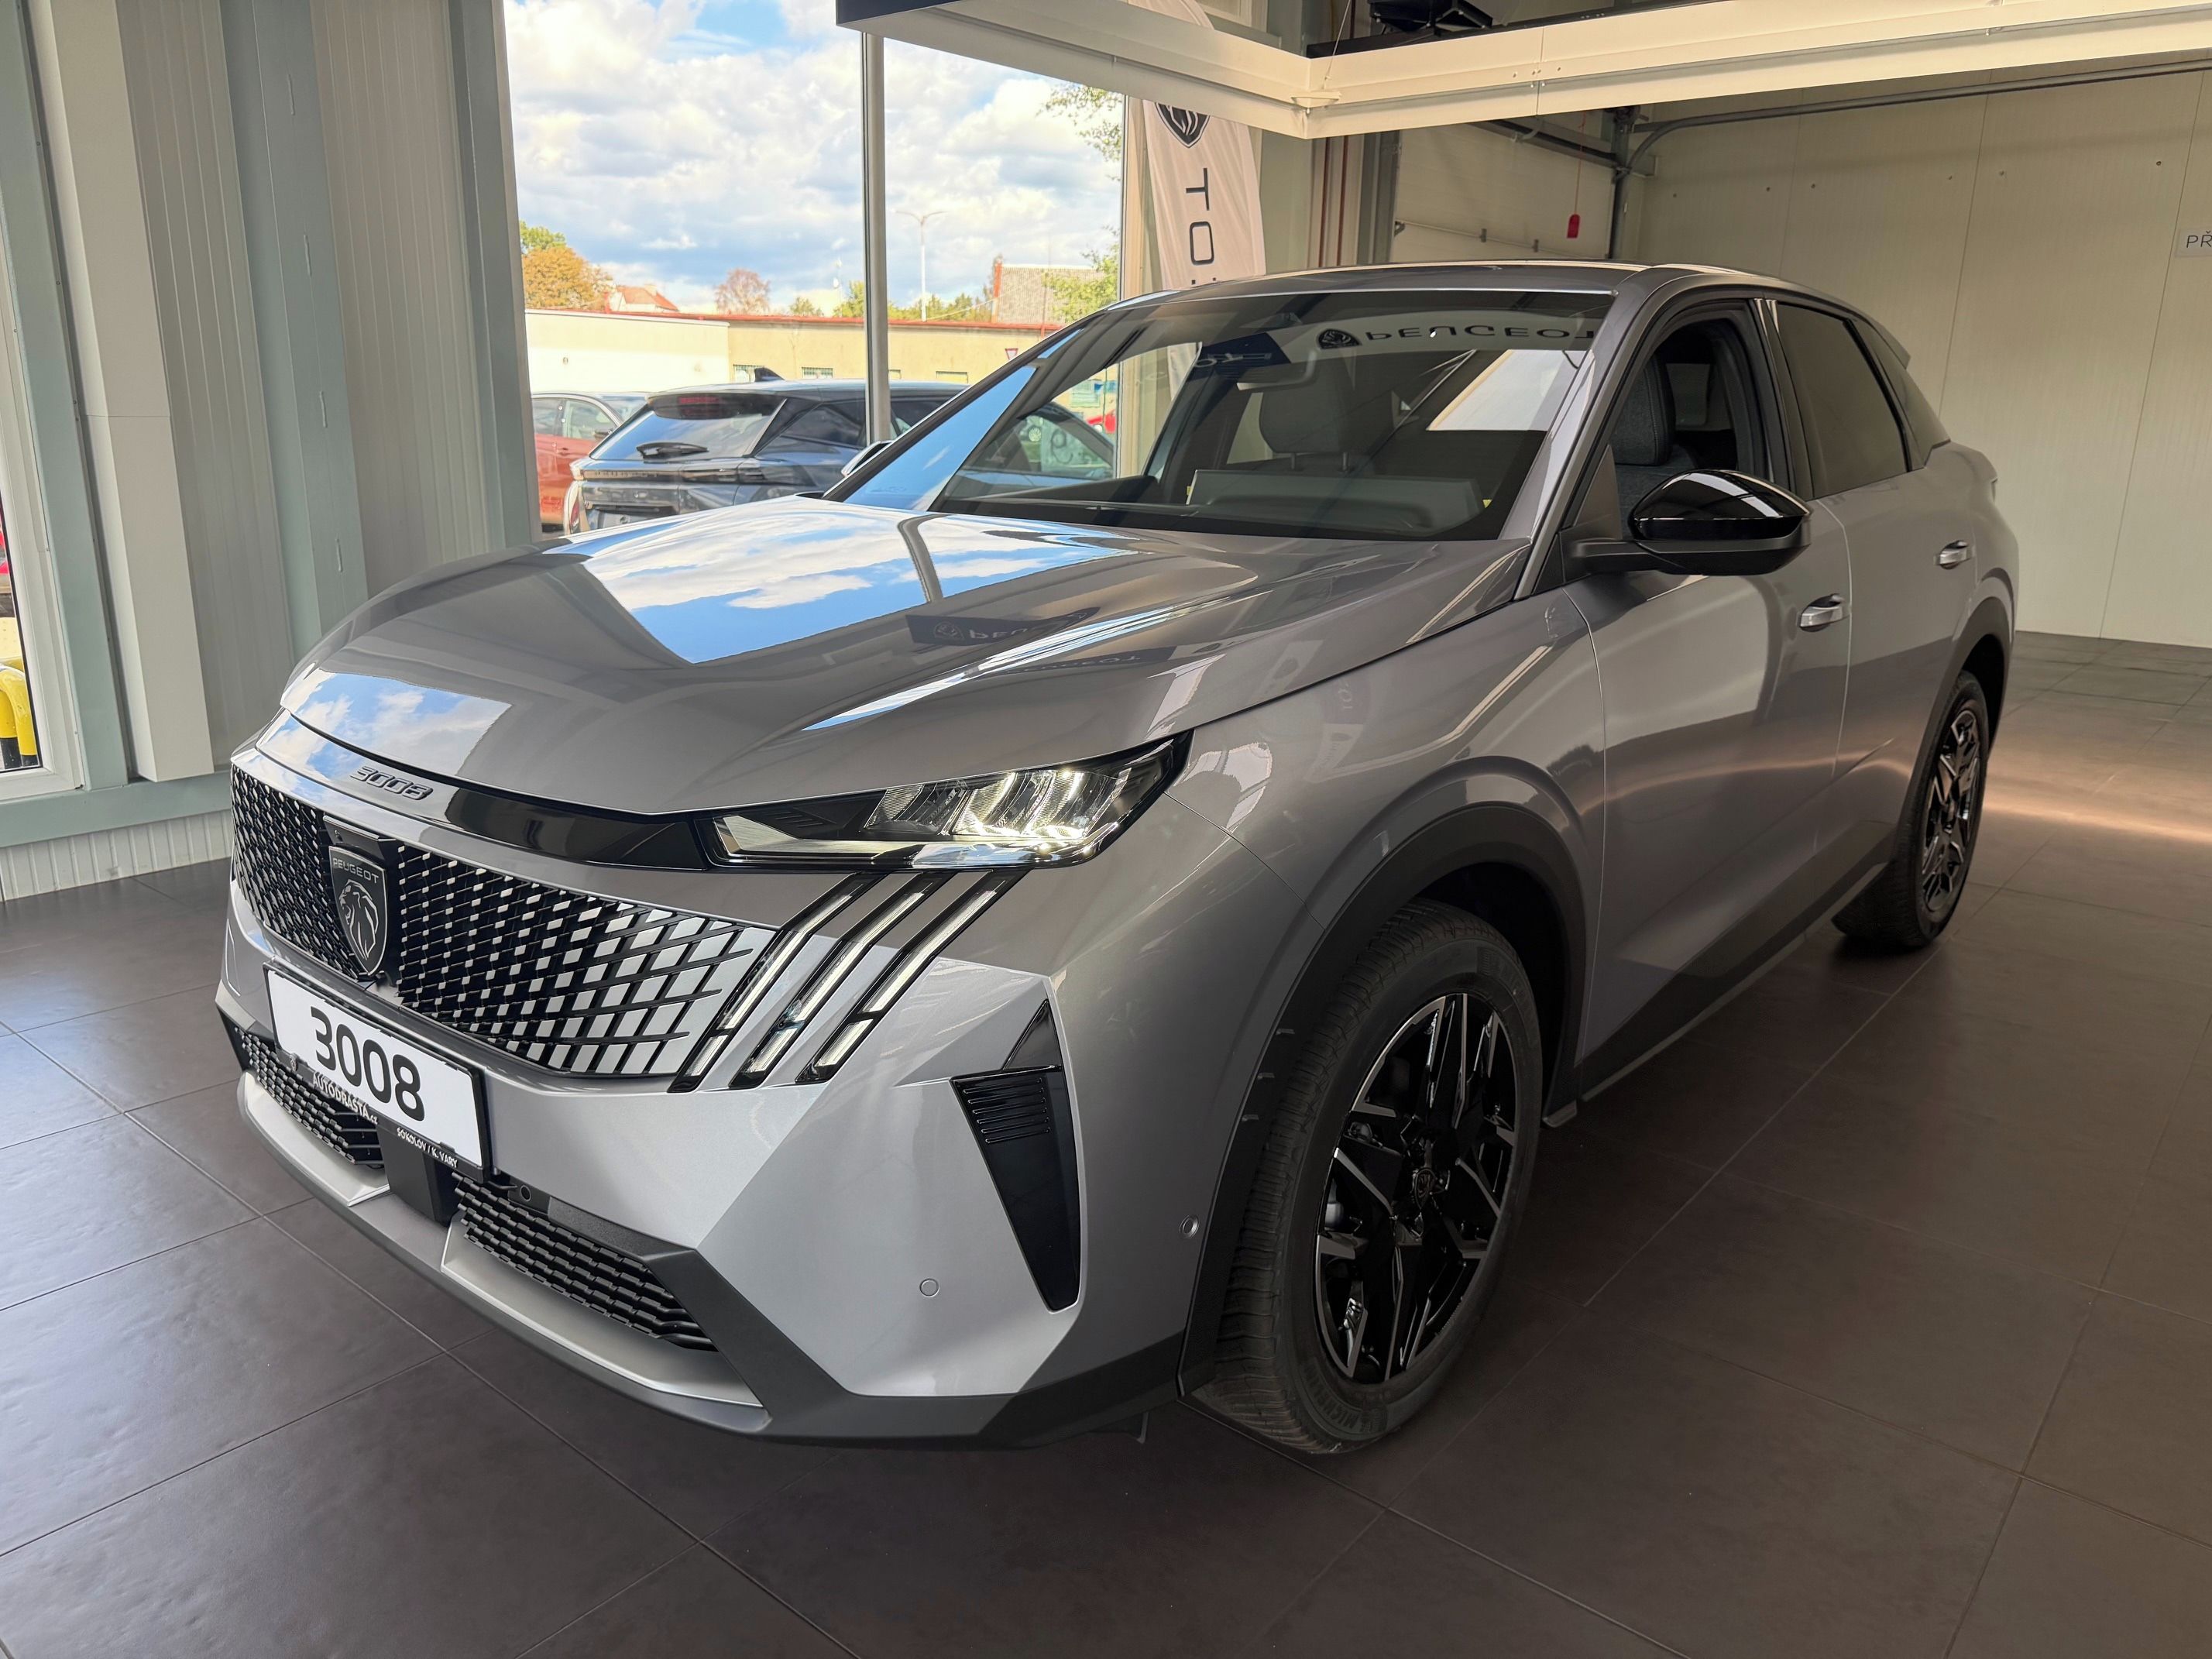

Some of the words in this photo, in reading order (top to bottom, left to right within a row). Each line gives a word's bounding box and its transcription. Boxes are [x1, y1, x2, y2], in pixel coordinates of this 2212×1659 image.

[350, 765, 434, 800] 3008
[332, 857, 379, 884] PEUGEOT
[311, 1006, 425, 1121] 3008
[397, 1127, 427, 1151] SOKOLOV
[439, 1151, 458, 1168] VARY
[1303, 1365, 1359, 1429] MICHELIN
